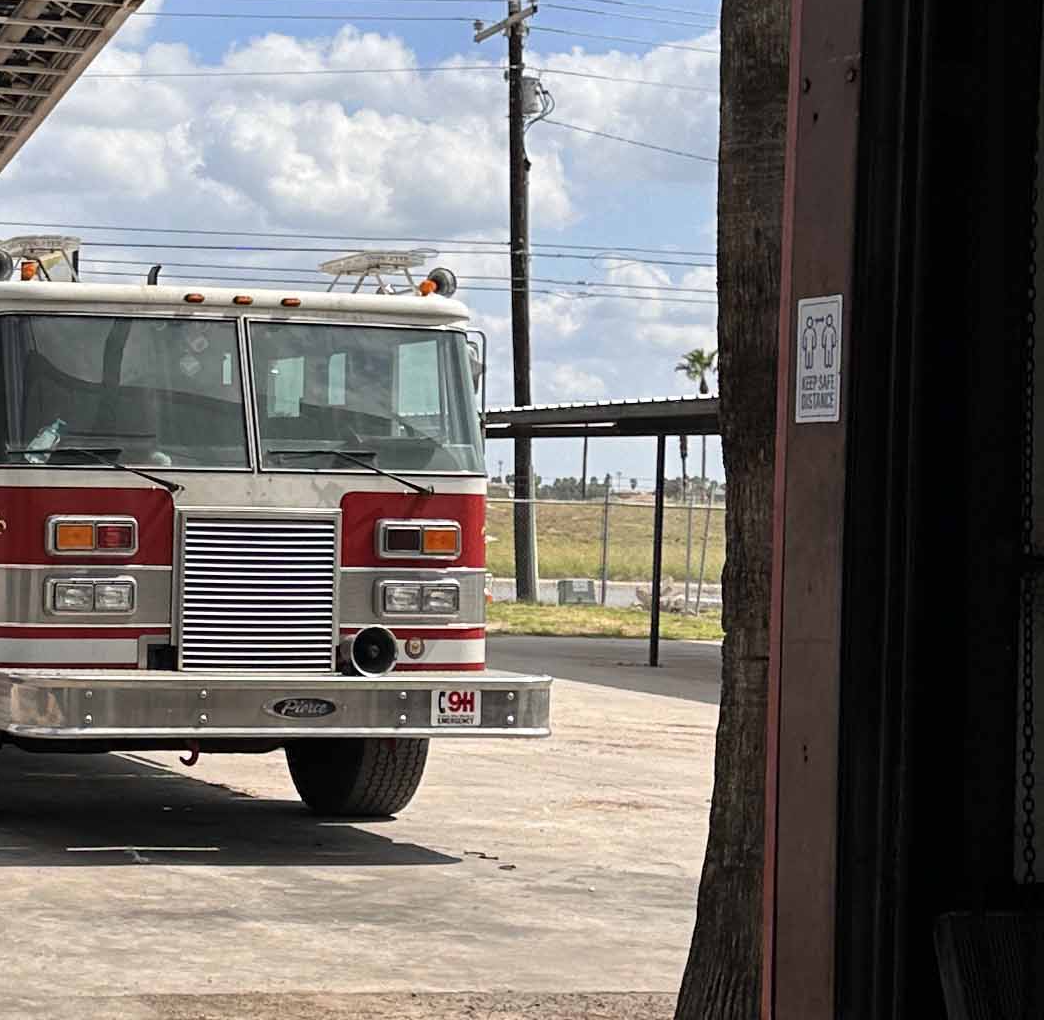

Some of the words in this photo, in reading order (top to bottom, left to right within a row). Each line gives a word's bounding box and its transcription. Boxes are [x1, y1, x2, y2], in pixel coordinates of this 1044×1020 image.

[801, 375, 817, 391] KEEP
[818, 373, 835, 390] SAFE
[801, 391, 835, 410] DISTANCE
